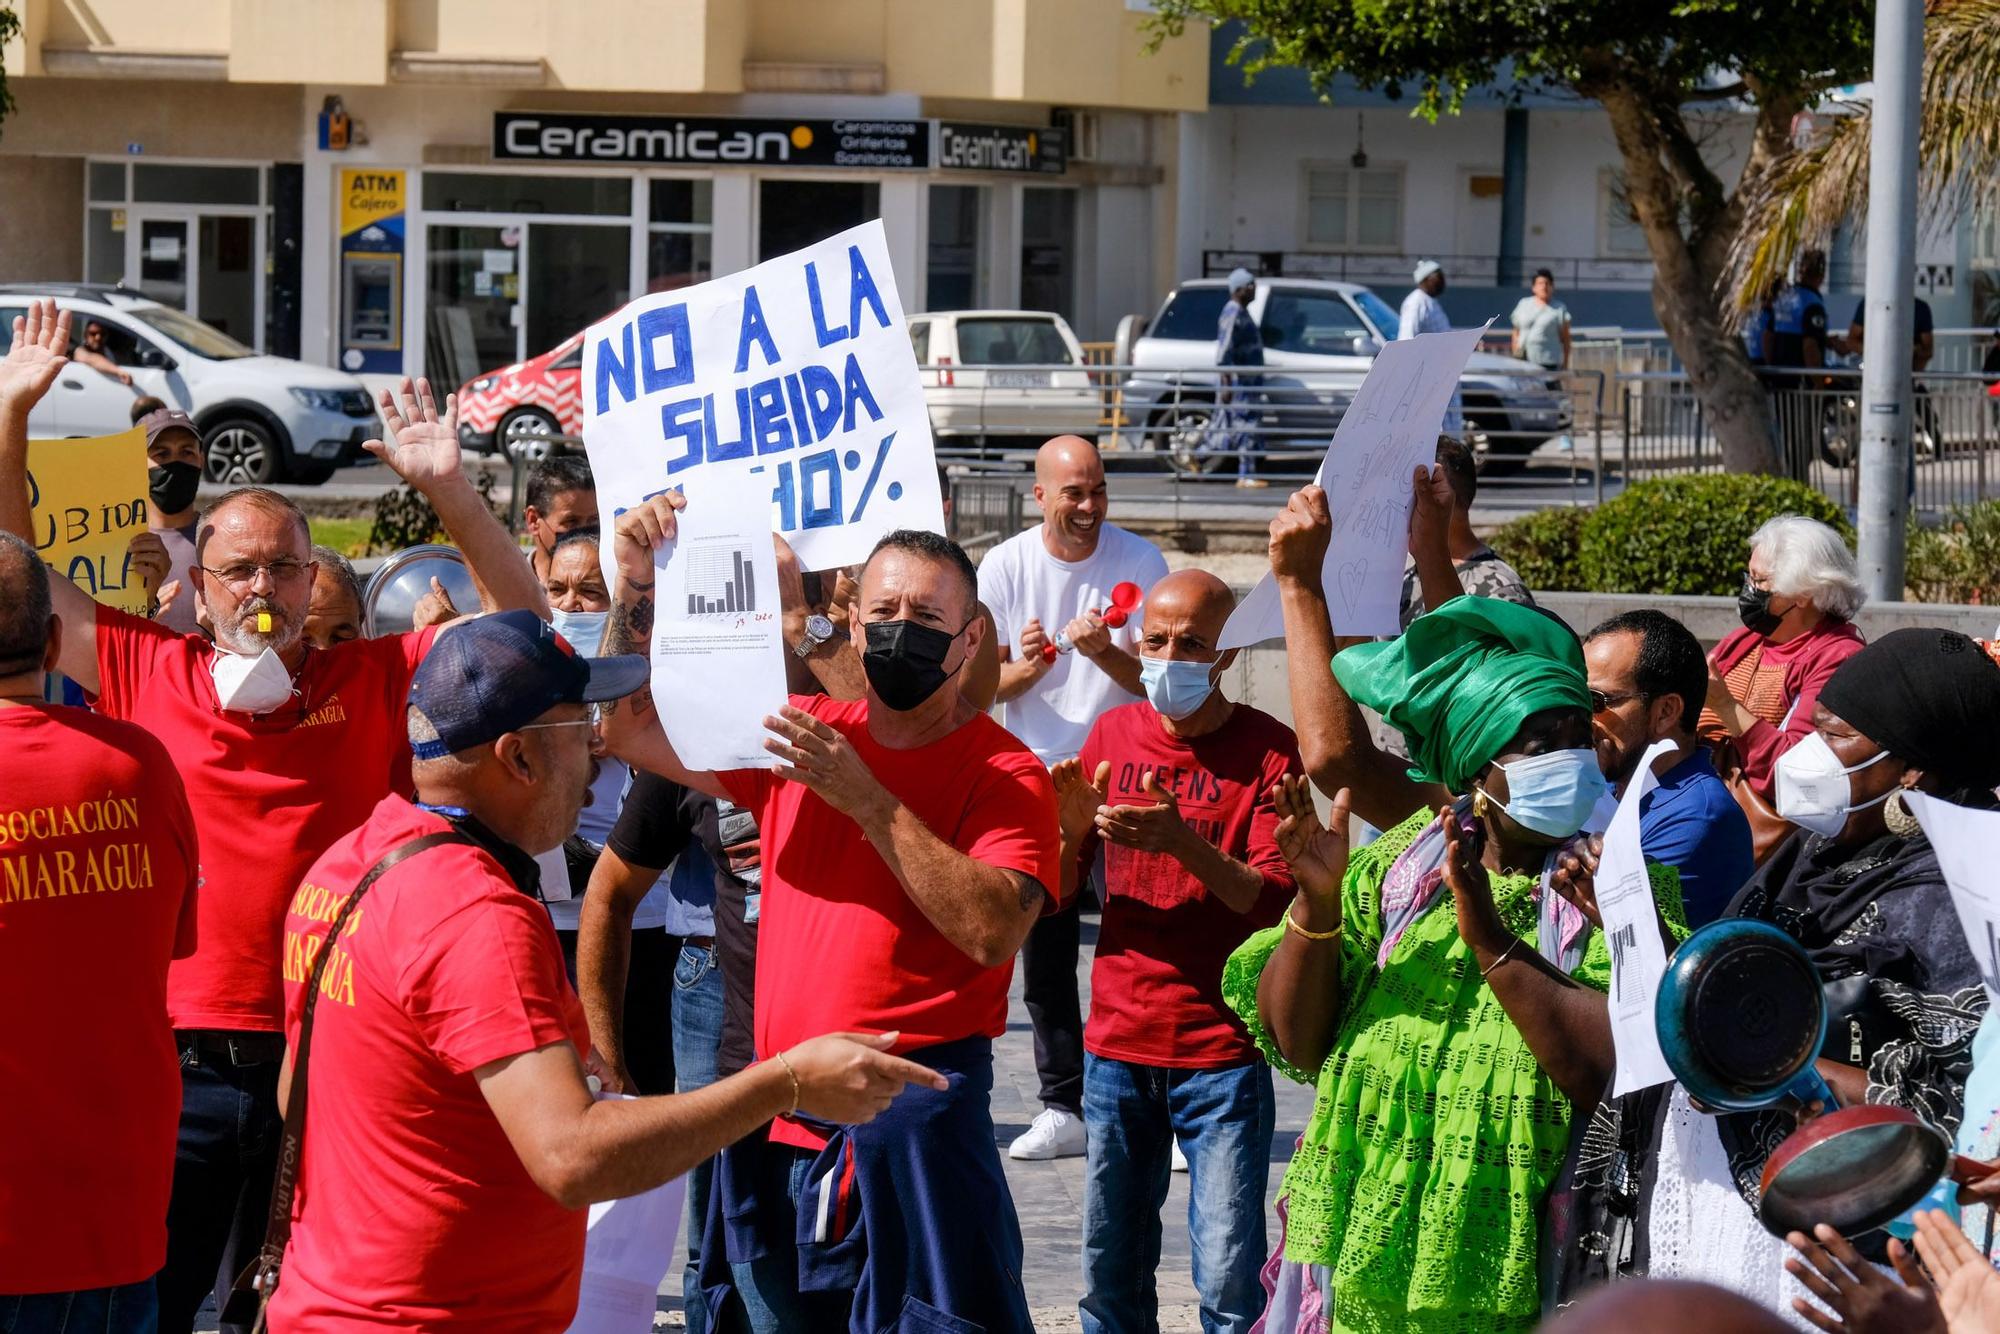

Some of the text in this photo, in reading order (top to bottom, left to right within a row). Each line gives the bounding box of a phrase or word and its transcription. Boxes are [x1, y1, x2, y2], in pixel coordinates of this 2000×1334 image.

[505, 119, 790, 161] Ceramican
[940, 126, 1031, 170] Ceramican
[349, 195, 398, 211] Cajero
[351, 175, 397, 192] ATM
[596, 244, 892, 416] NO A LA
[661, 352, 885, 476] SUBIDA
[1118, 762, 1223, 804] QUEENS
[0, 789, 139, 845] SOCIACIÓN
[0, 843, 154, 903] MARAGUA
[274, 1133, 297, 1221] VUITTON
